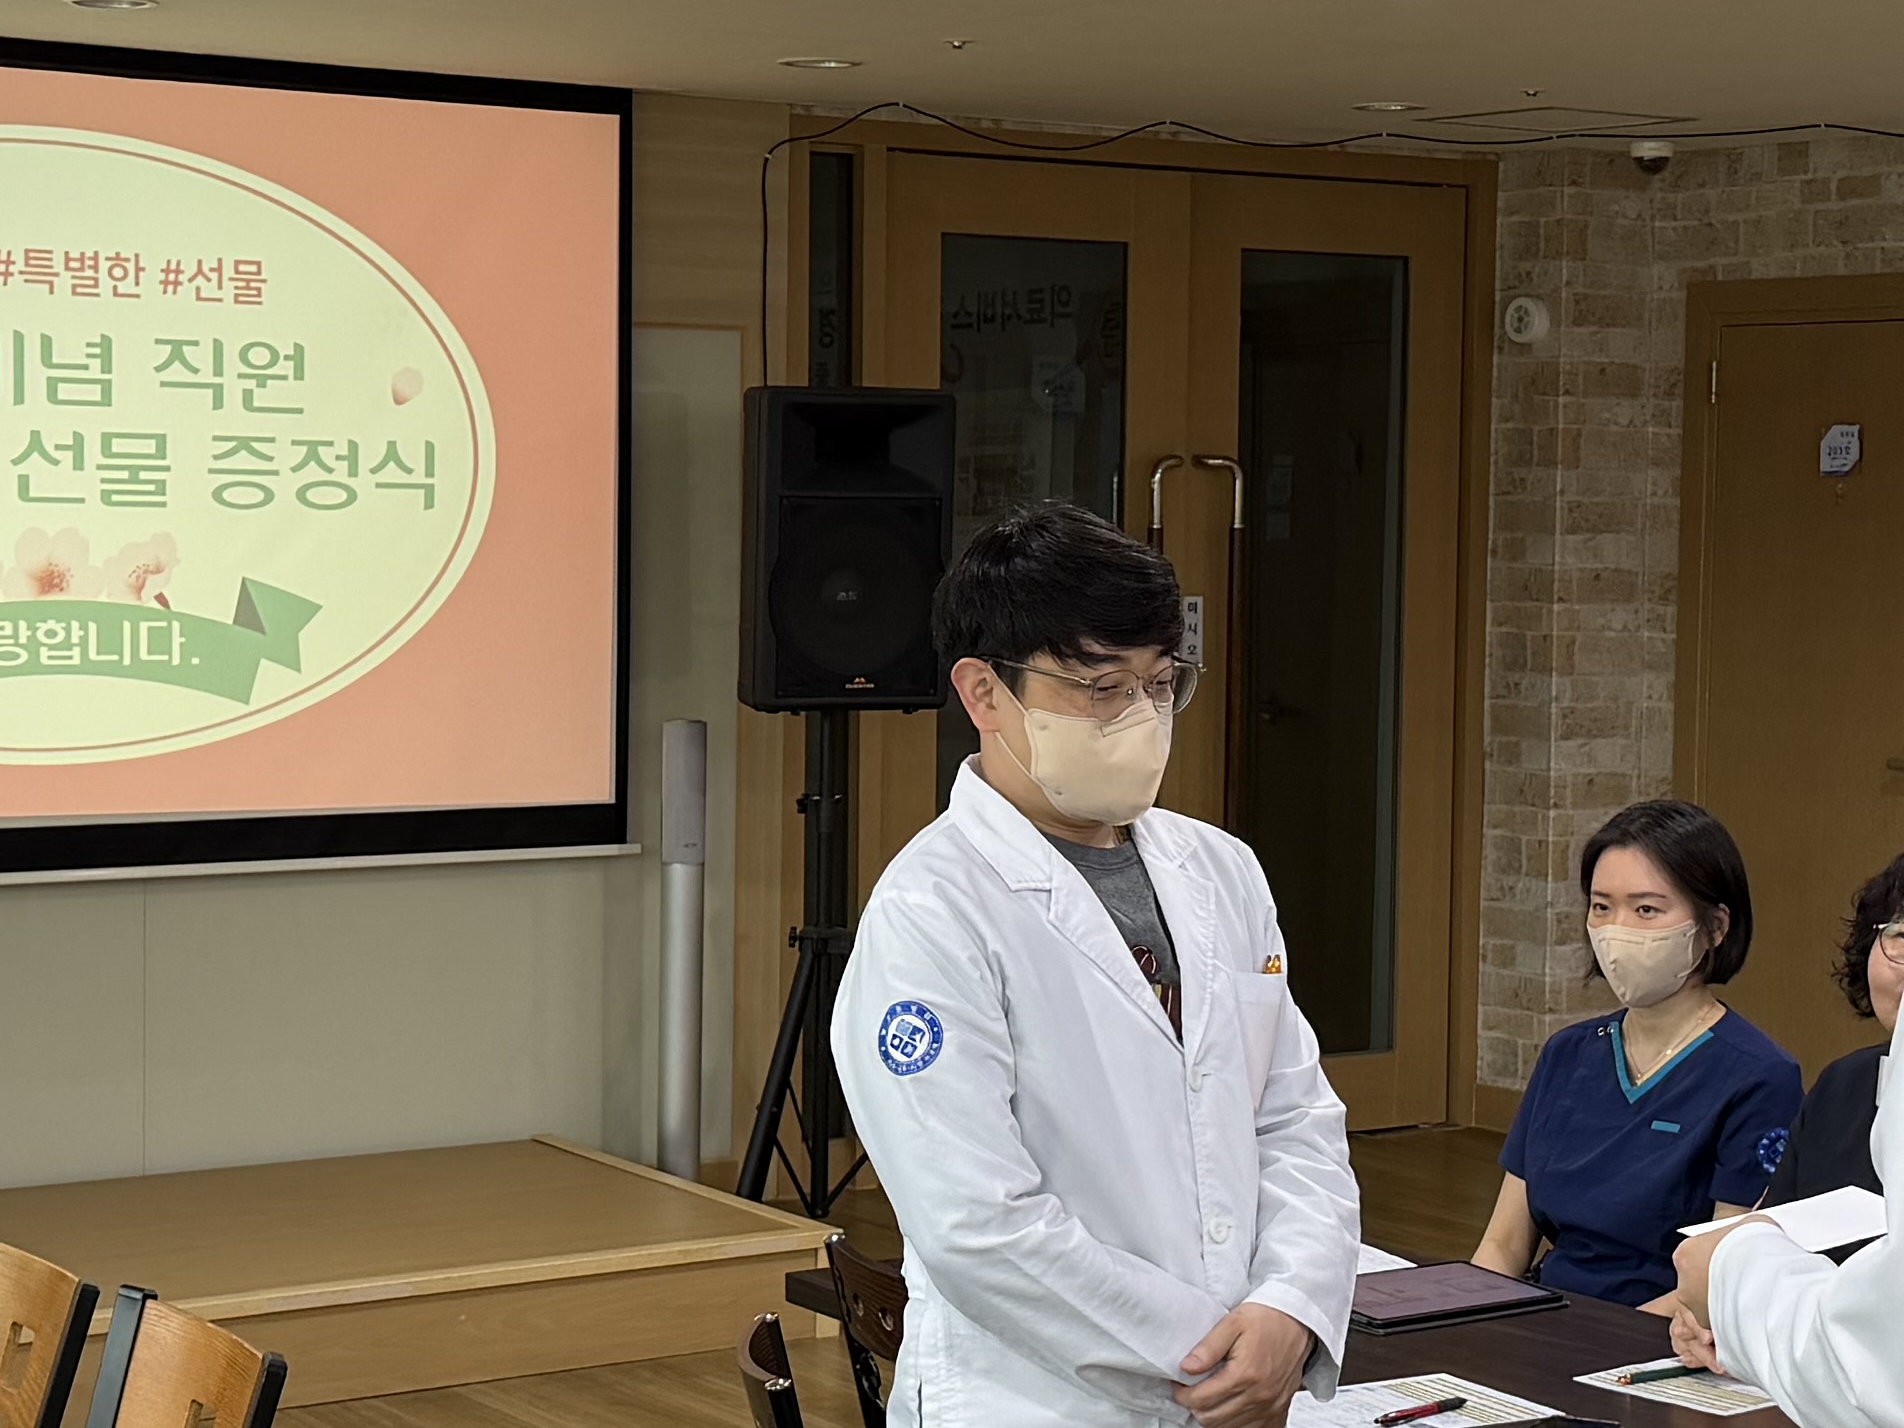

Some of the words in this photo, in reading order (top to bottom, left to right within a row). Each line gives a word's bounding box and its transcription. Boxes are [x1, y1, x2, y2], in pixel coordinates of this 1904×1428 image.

[158, 257, 268, 306] #선물
[152, 336, 307, 416] 직원
[8, 429, 173, 510] 선물
[205, 432, 439, 512] 증정식
